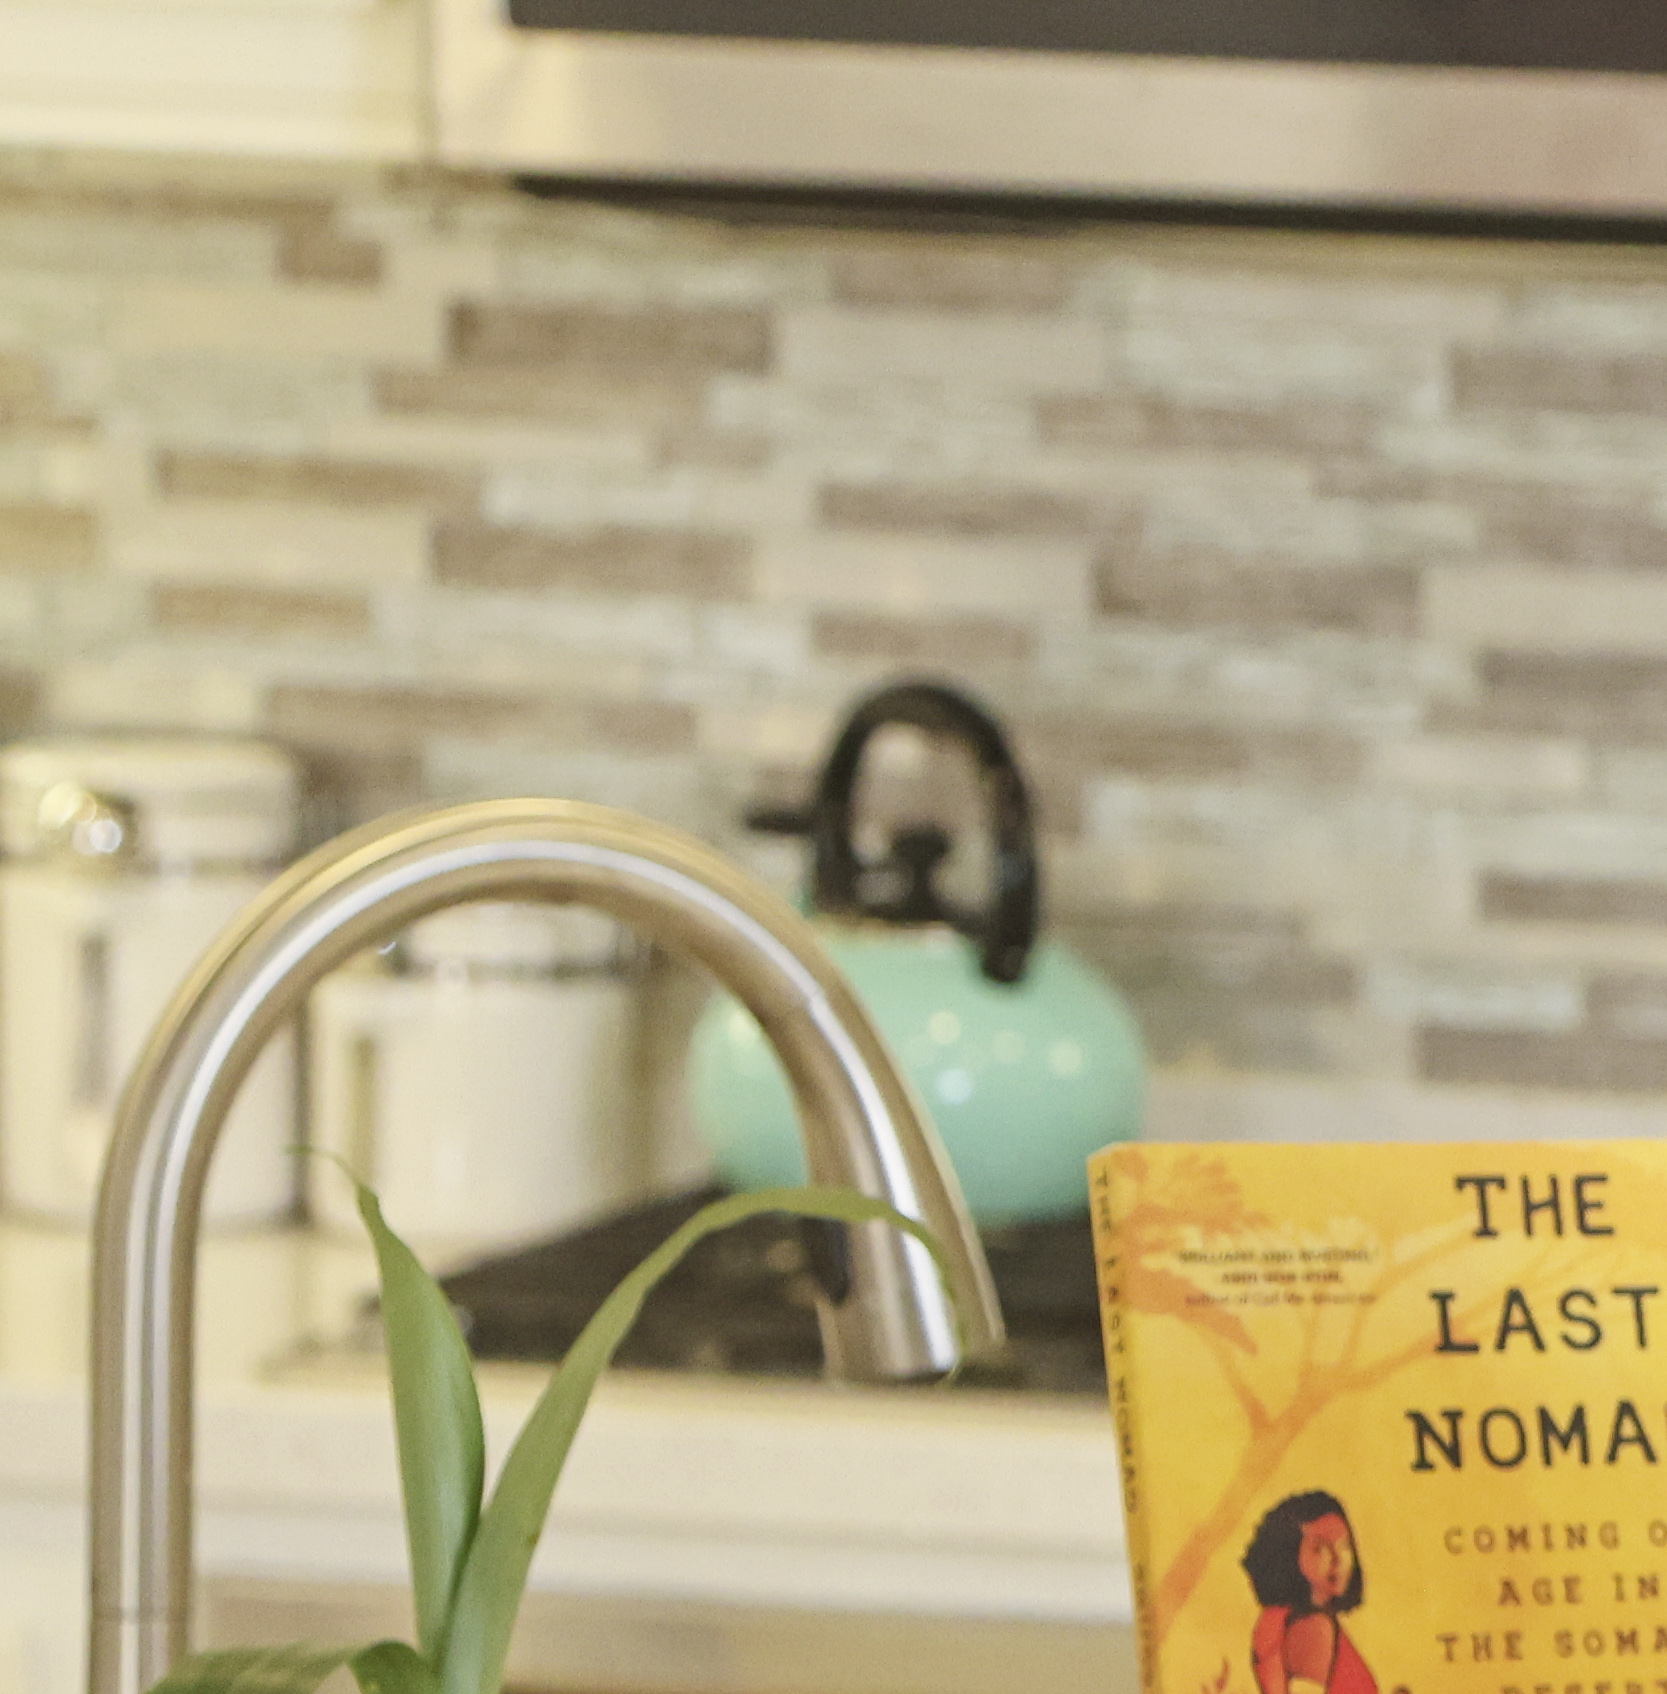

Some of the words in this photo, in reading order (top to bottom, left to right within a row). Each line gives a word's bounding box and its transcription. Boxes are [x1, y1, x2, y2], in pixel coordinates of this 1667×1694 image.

[1455, 1174, 1615, 1237] THE
[1428, 1286, 1659, 1353] LAST
[1443, 1520, 1620, 1555] COMING
[1498, 1575, 1582, 1607] AGE
[1613, 1572, 1660, 1602] IN
[1436, 1629, 1523, 1663] THE
